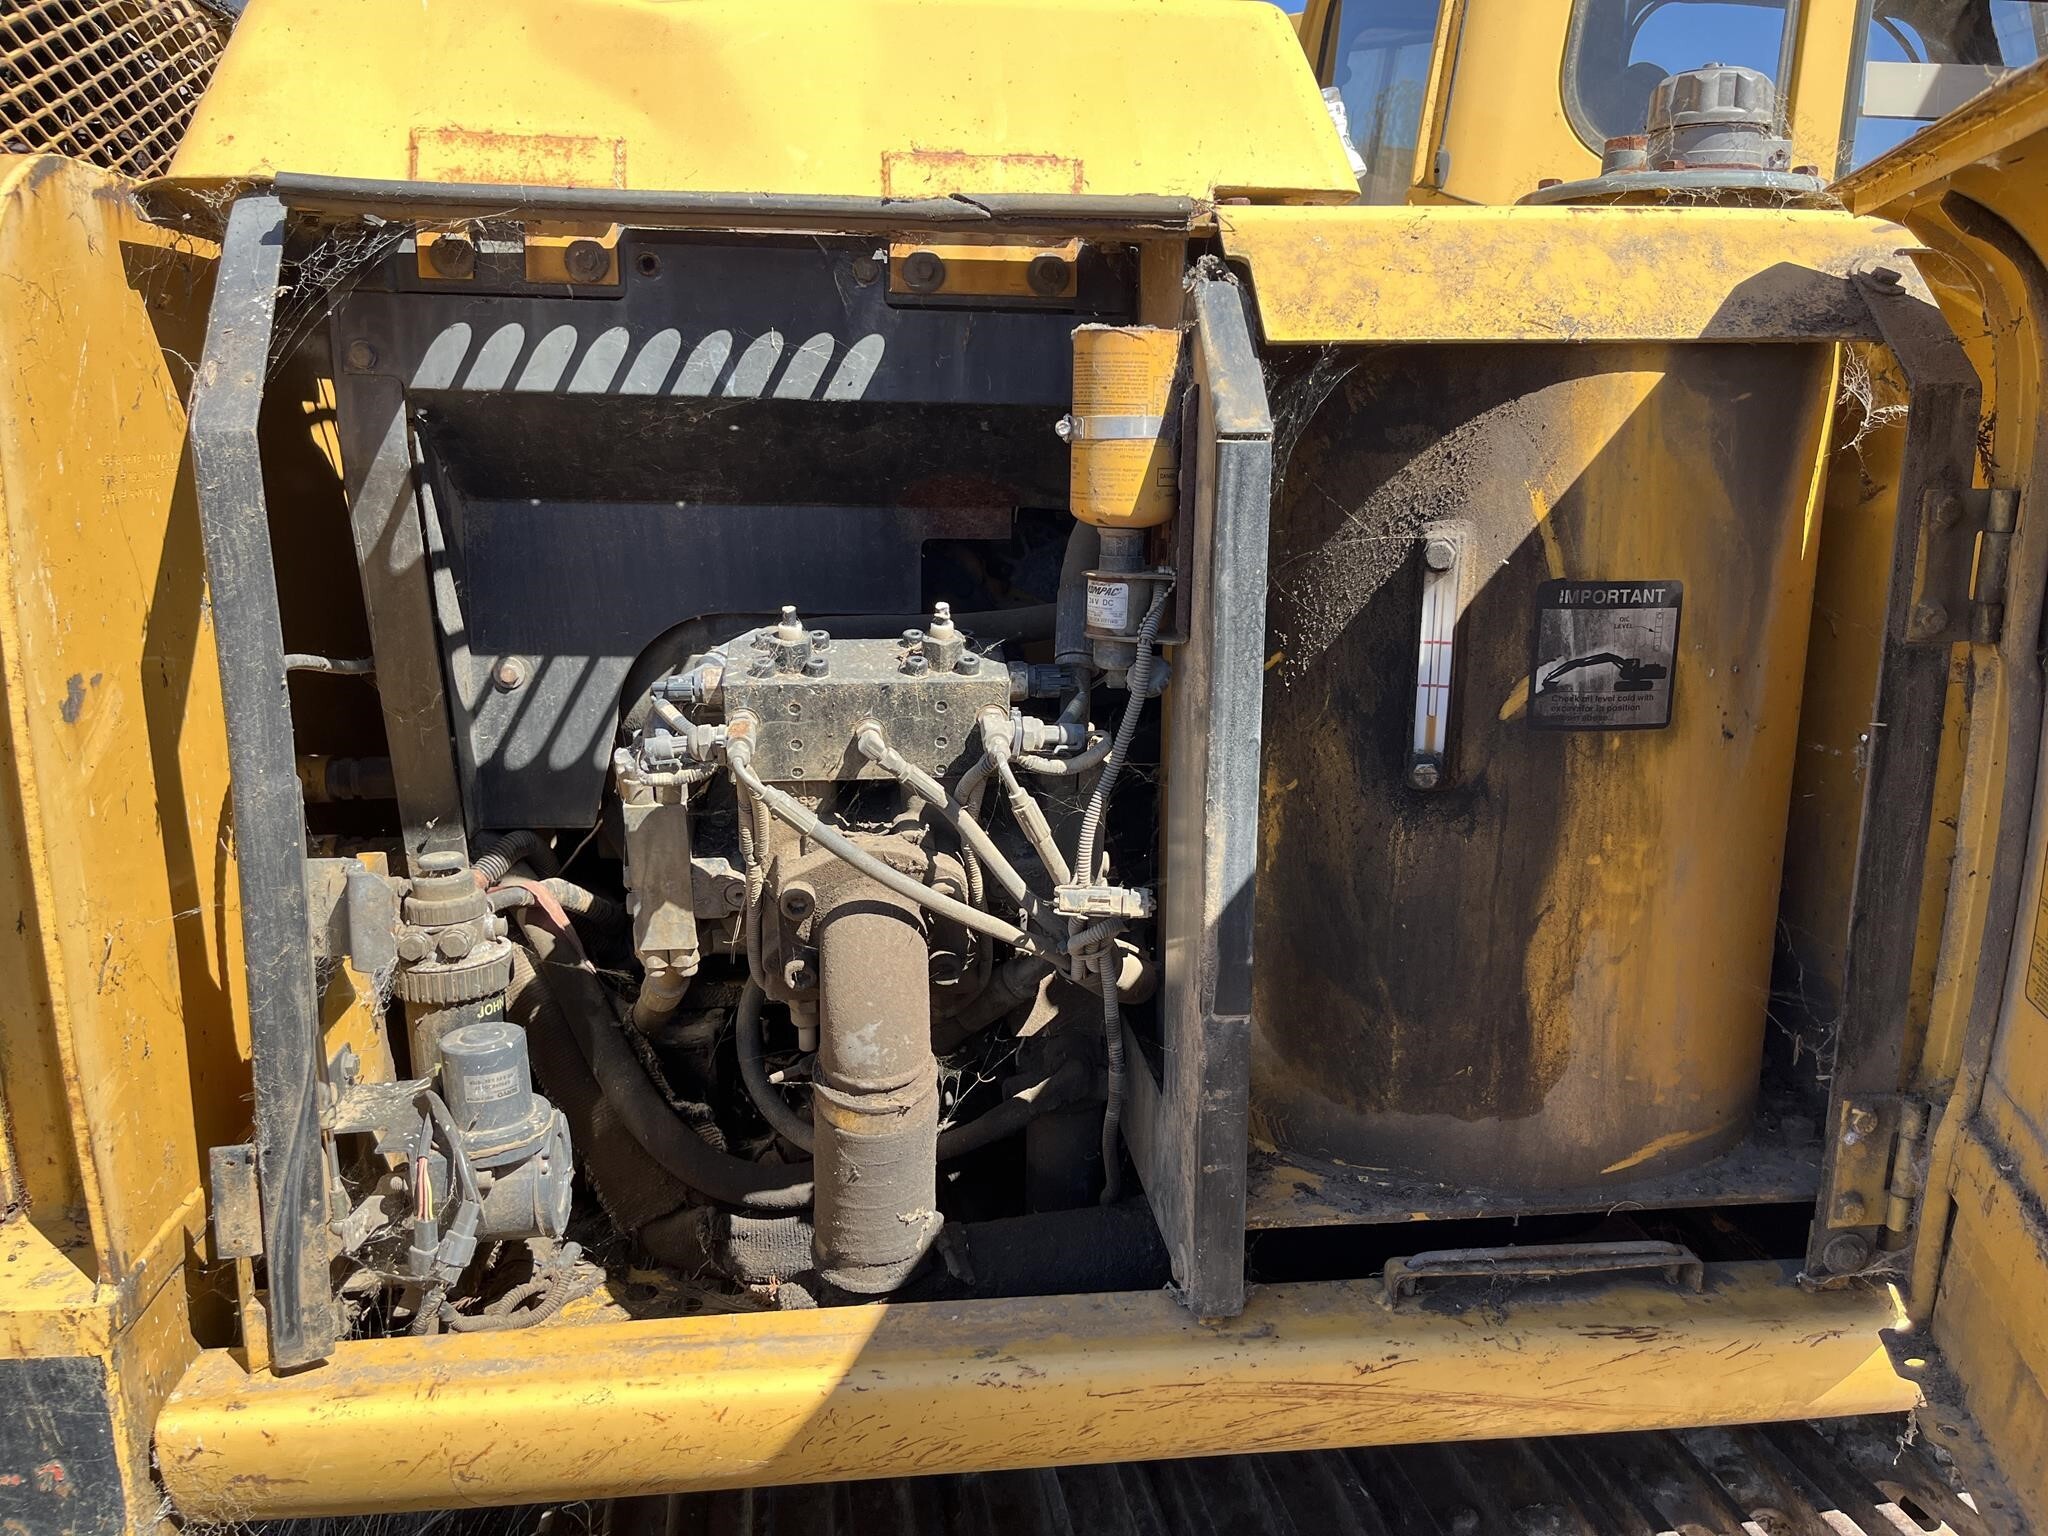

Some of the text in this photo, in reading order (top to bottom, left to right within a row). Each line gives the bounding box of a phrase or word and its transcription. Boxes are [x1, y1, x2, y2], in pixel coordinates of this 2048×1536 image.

[1559, 588, 1666, 604] IMPORTANT
[1606, 703, 1641, 714] position
[477, 995, 505, 1019] JOHN
